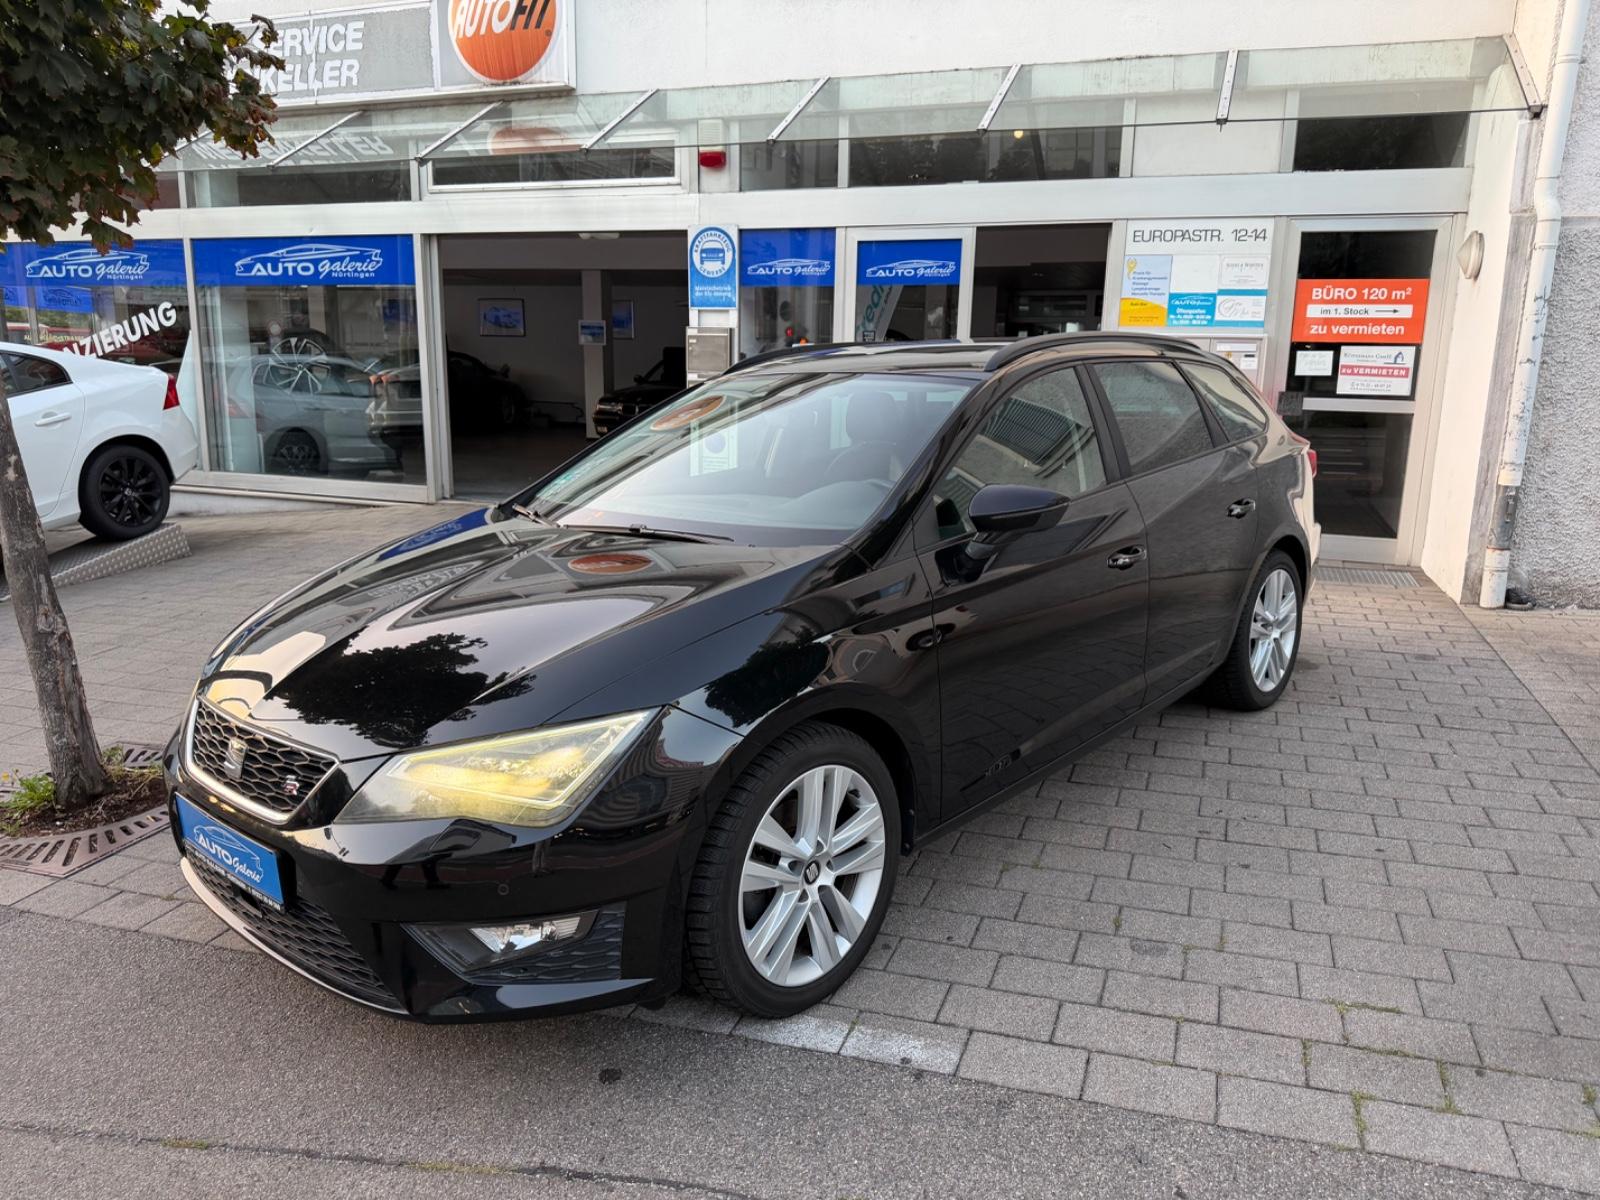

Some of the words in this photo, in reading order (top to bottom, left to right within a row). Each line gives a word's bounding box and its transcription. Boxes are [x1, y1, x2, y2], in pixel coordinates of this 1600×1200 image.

[1132, 229, 1224, 243] EUROPASTR.
[1231, 228, 1268, 242] 12-14
[40, 265, 92, 278] AUTO
[95, 260, 145, 281] galerie
[251, 262, 314, 276] AUTO
[318, 256, 377, 279] galerie
[757, 267, 793, 275] AUTO
[877, 269, 915, 277] AUTO
[1311, 285, 1356, 300] BÜRO
[1362, 287, 1387, 300] 120
[1320, 307, 1331, 315] im
[1334, 307, 1341, 315] 1.
[1344, 307, 1369, 315] Stock
[1309, 325, 1327, 335] zu
[1331, 323, 1405, 335] vermieten
[1353, 367, 1406, 376] VERMIETEN
[198, 833, 233, 866] AUTO
